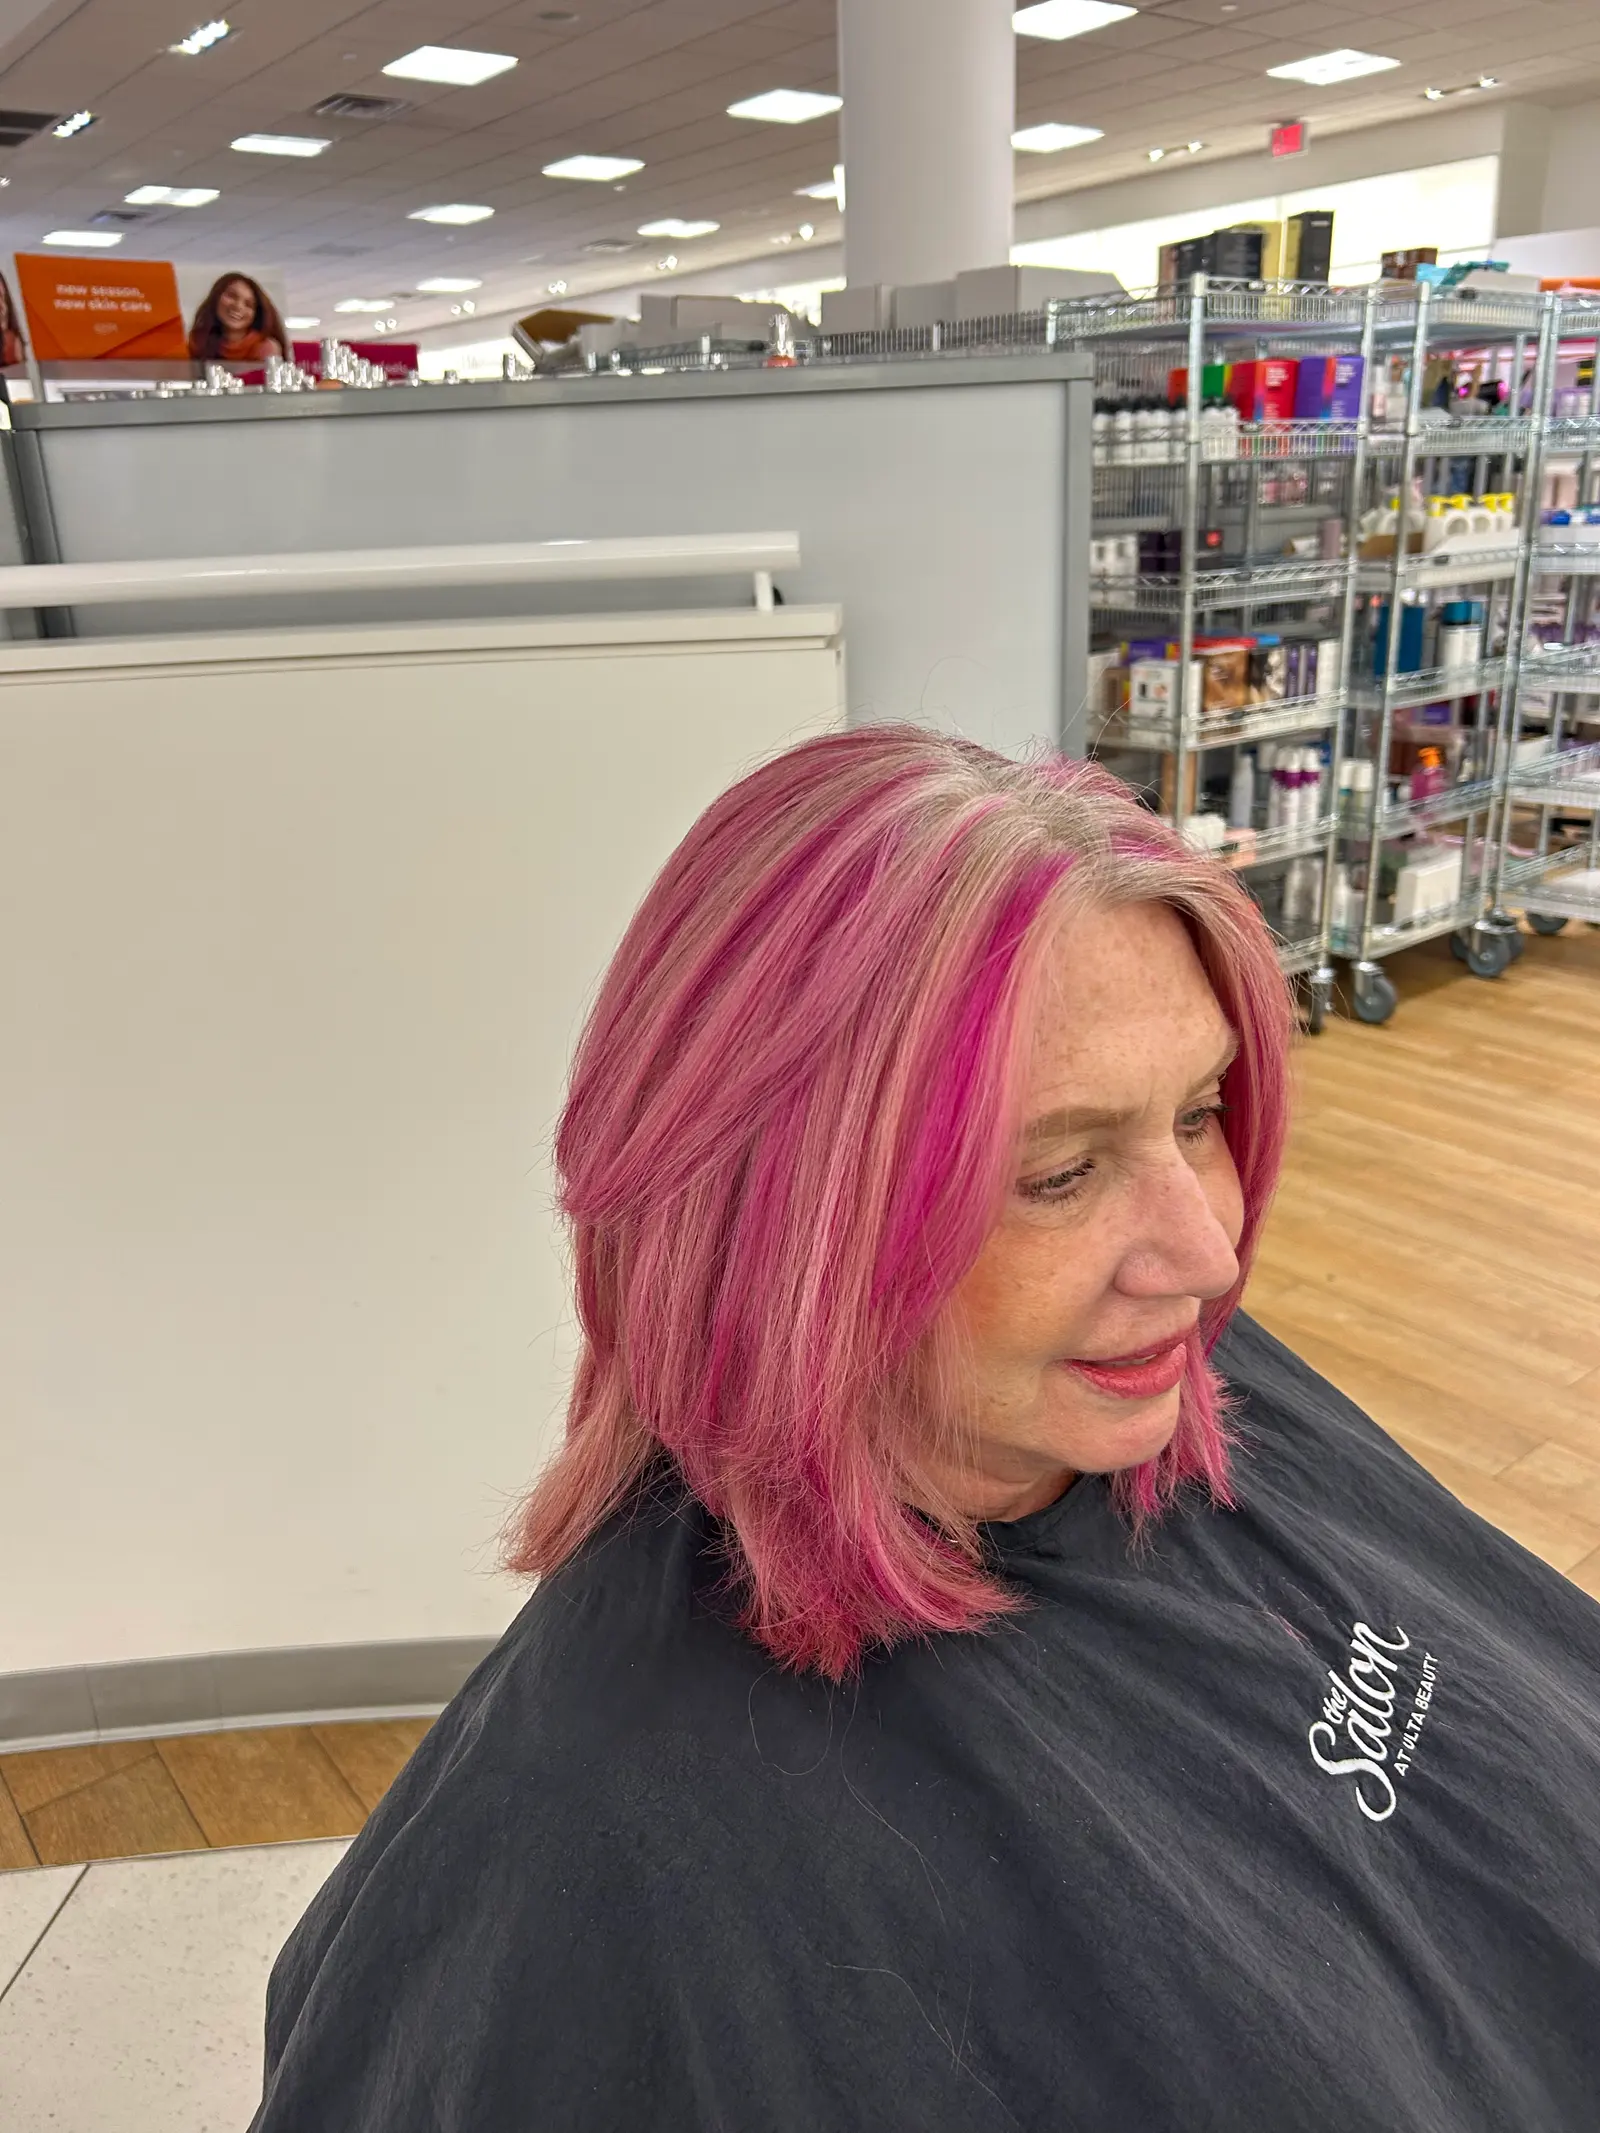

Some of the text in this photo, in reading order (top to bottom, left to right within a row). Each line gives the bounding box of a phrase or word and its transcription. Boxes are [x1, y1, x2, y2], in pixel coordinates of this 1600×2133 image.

[53, 297, 151, 312] new skin care
[56, 284, 87, 295] new
[1308, 1621, 1410, 1822] Salon
[1322, 1687, 1347, 1725] the
[1393, 1652, 1439, 1777] AT ULTA BEAUTY
